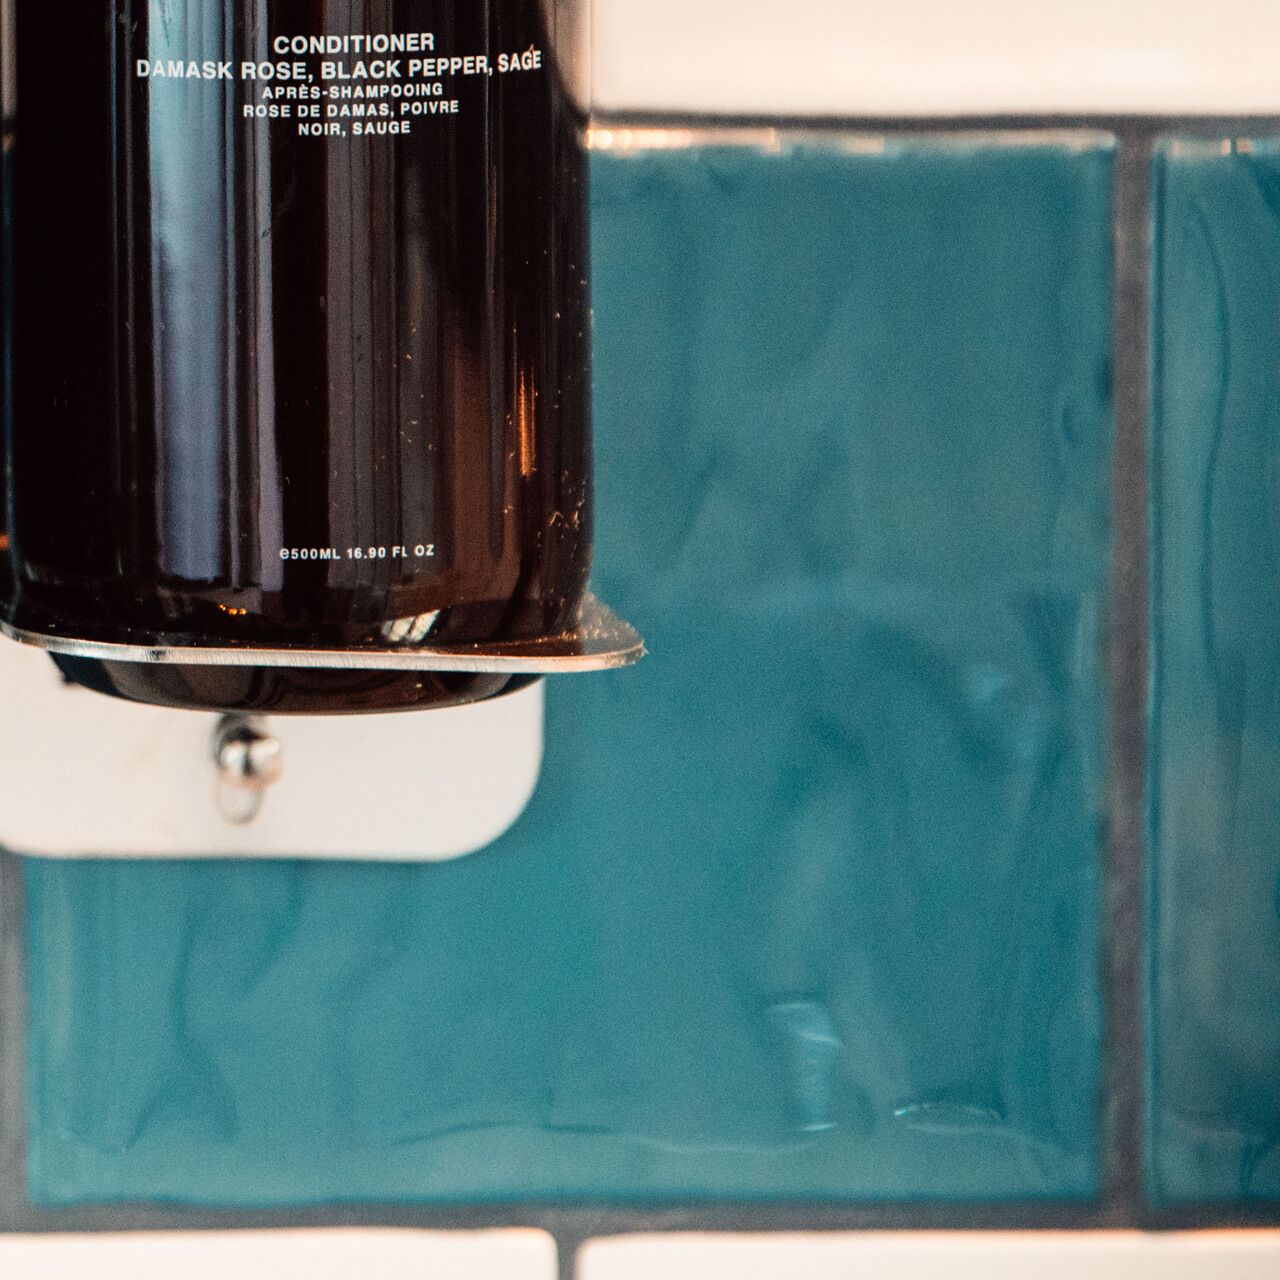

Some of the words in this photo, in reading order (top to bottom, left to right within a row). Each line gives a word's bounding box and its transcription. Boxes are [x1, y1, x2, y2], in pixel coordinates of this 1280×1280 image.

[273, 33, 434, 54] CONDITIONER
[136, 59, 233, 80] DAMASK
[241, 61, 314, 82] ROSE,
[321, 59, 402, 80] BLACK
[409, 56, 493, 78] PEPPER,
[498, 50, 541, 73] SAGE
[262, 83, 443, 100] APRÈS-SHAMPOOING
[244, 104, 291, 118] ROSE
[297, 104, 320, 118] DE
[327, 102, 395, 118] DAMAS,
[401, 99, 459, 116] POIVRE
[298, 122, 347, 137] NOIR,
[353, 120, 411, 135] SAUGE
[347, 547, 386, 560] 16.90
[392, 546, 408, 558] FL
[414, 544, 435, 557] OZ
